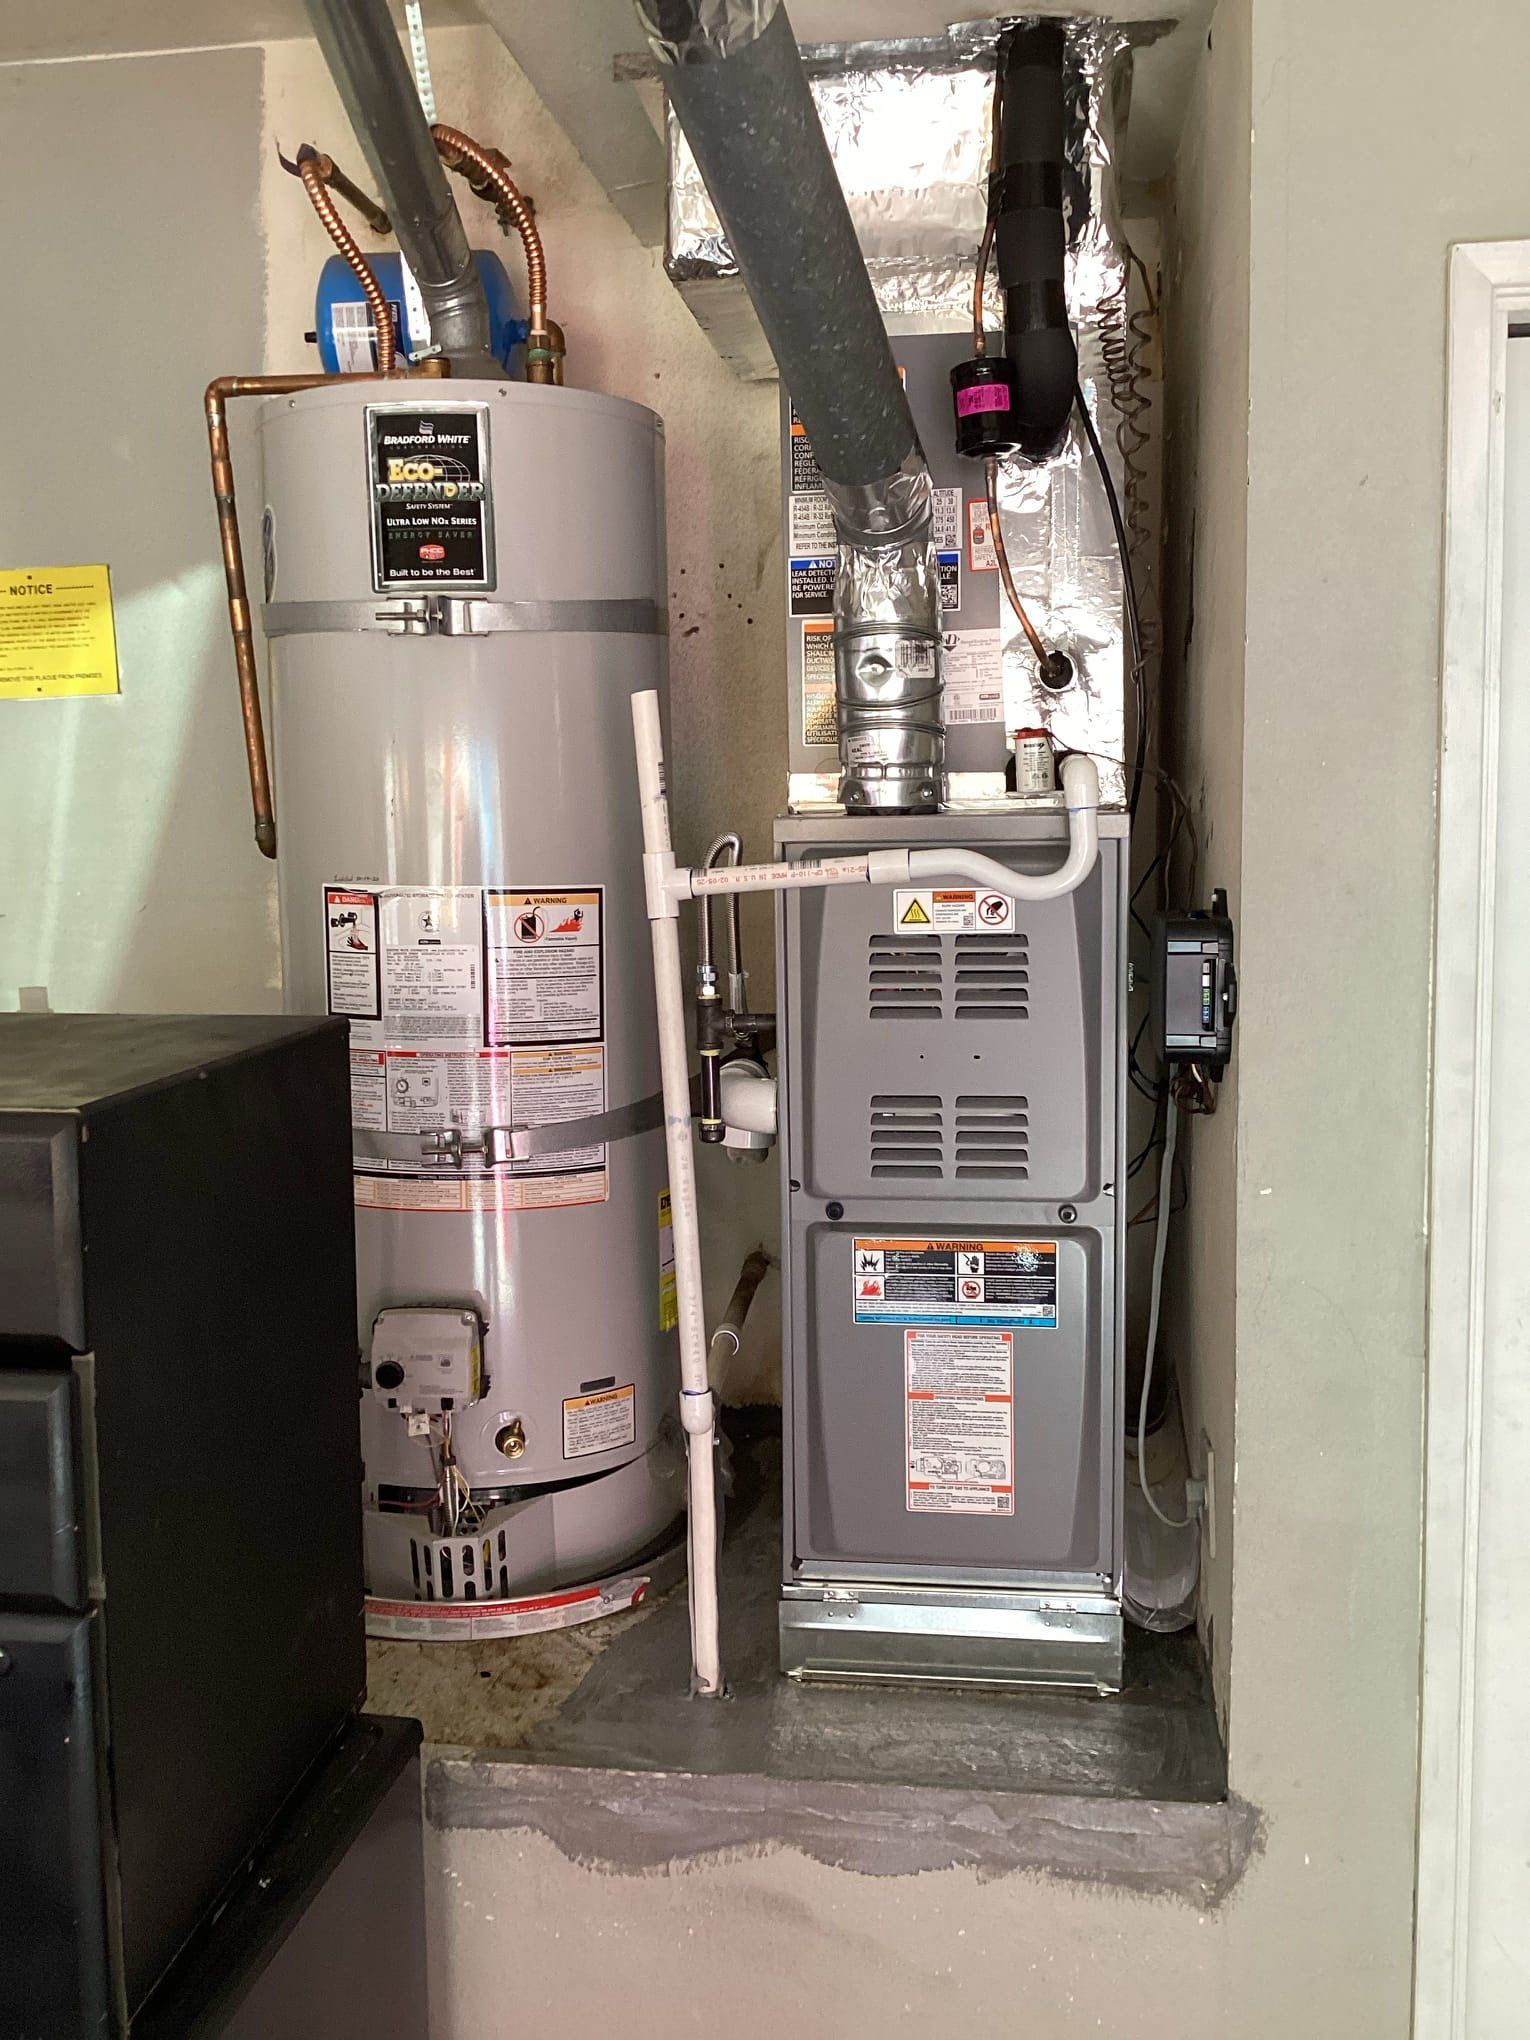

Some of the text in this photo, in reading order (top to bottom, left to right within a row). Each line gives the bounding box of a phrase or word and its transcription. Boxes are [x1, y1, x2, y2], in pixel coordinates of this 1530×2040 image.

[384, 434, 470, 445] BRADFORD WHITE
[375, 482, 484, 501] DEFENDER
[387, 518, 410, 526] ULTRA
[451, 517, 477, 526] SERIES
[390, 568, 474, 577] Built to be the Best
[10, 584, 53, 596] NOTICE
[934, 1243, 984, 1251] WARNING
